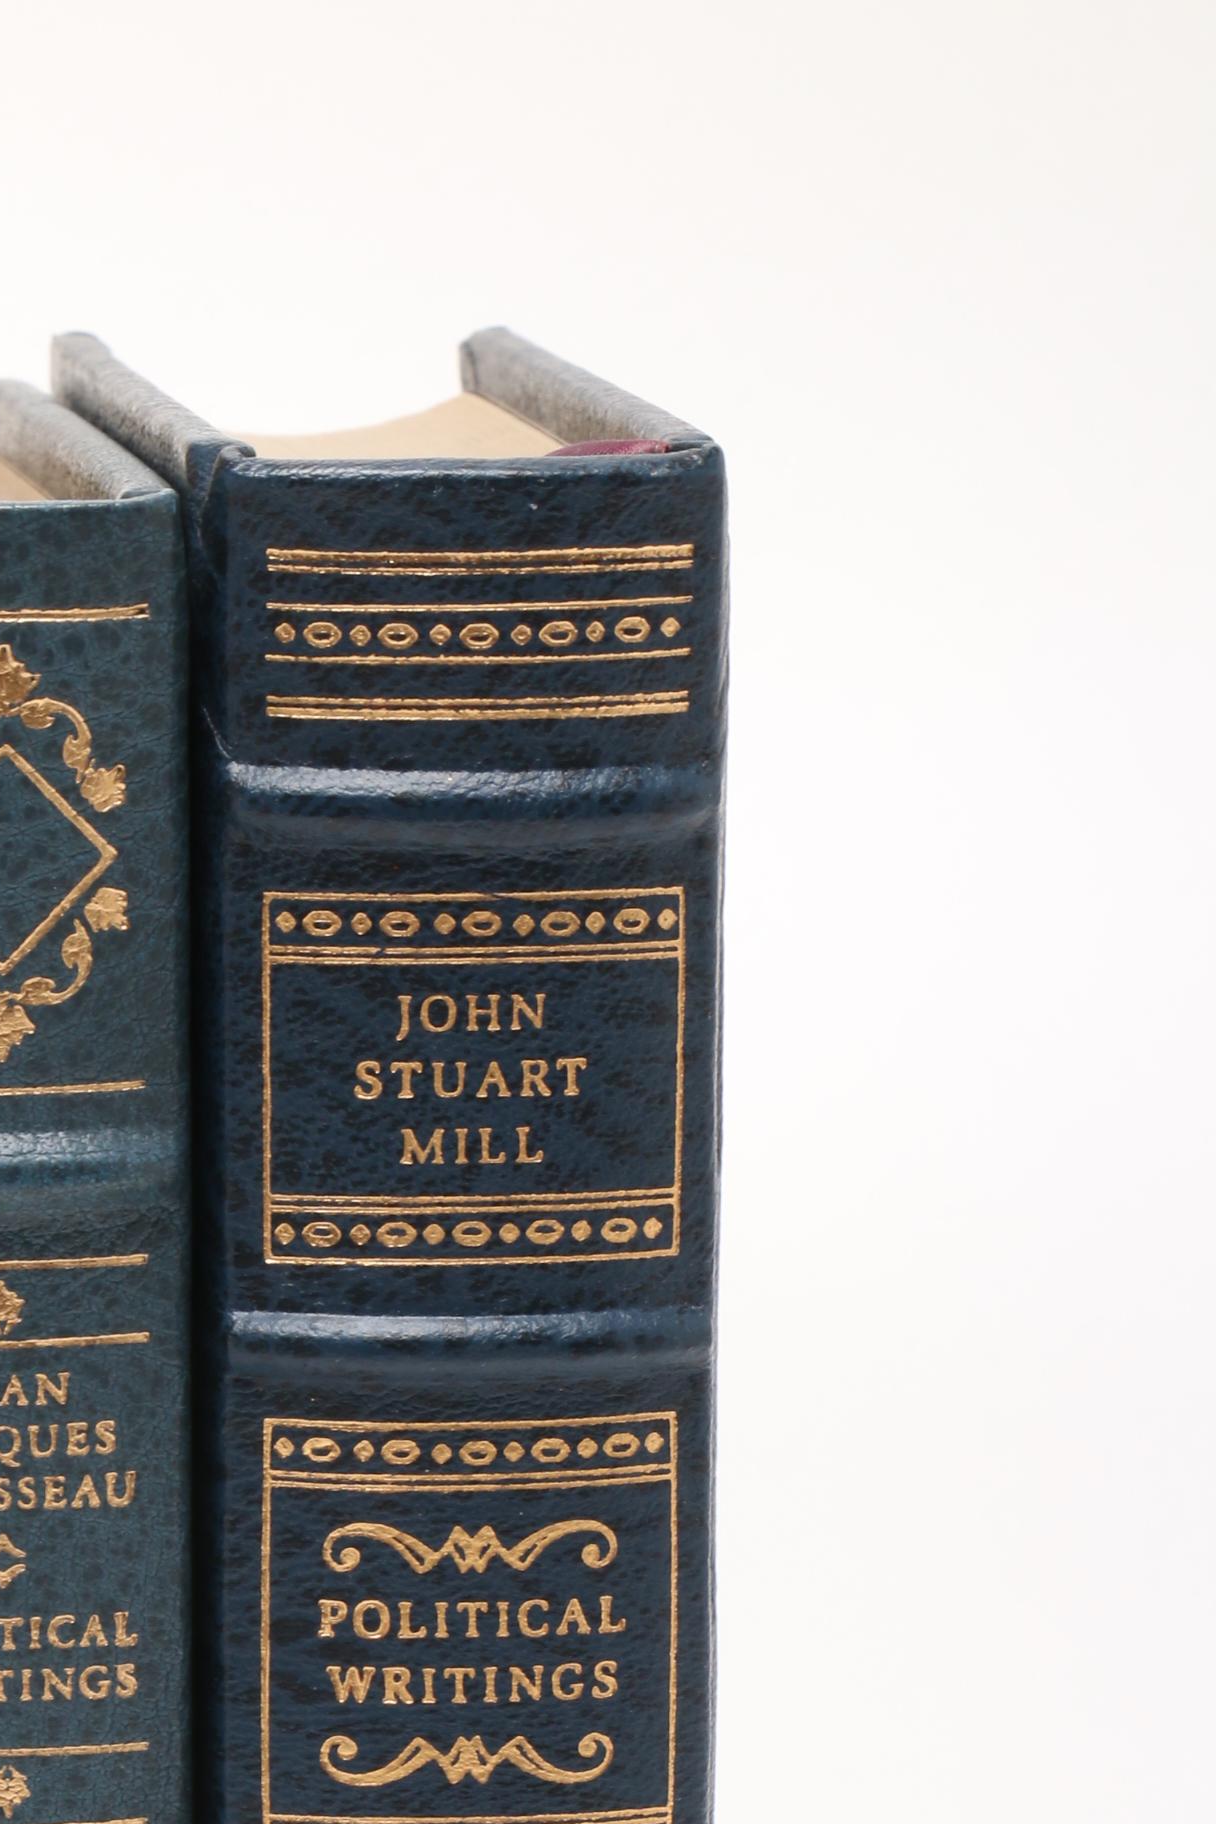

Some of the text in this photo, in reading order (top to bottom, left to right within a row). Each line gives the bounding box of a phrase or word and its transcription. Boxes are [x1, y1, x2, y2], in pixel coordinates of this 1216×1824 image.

[395, 993, 547, 1042] JOHN
[353, 1057, 588, 1101] STUART
[399, 1126, 544, 1166] MILL
[317, 1594, 627, 1640] POLITICAL
[325, 1660, 619, 1705] WRITINGS
